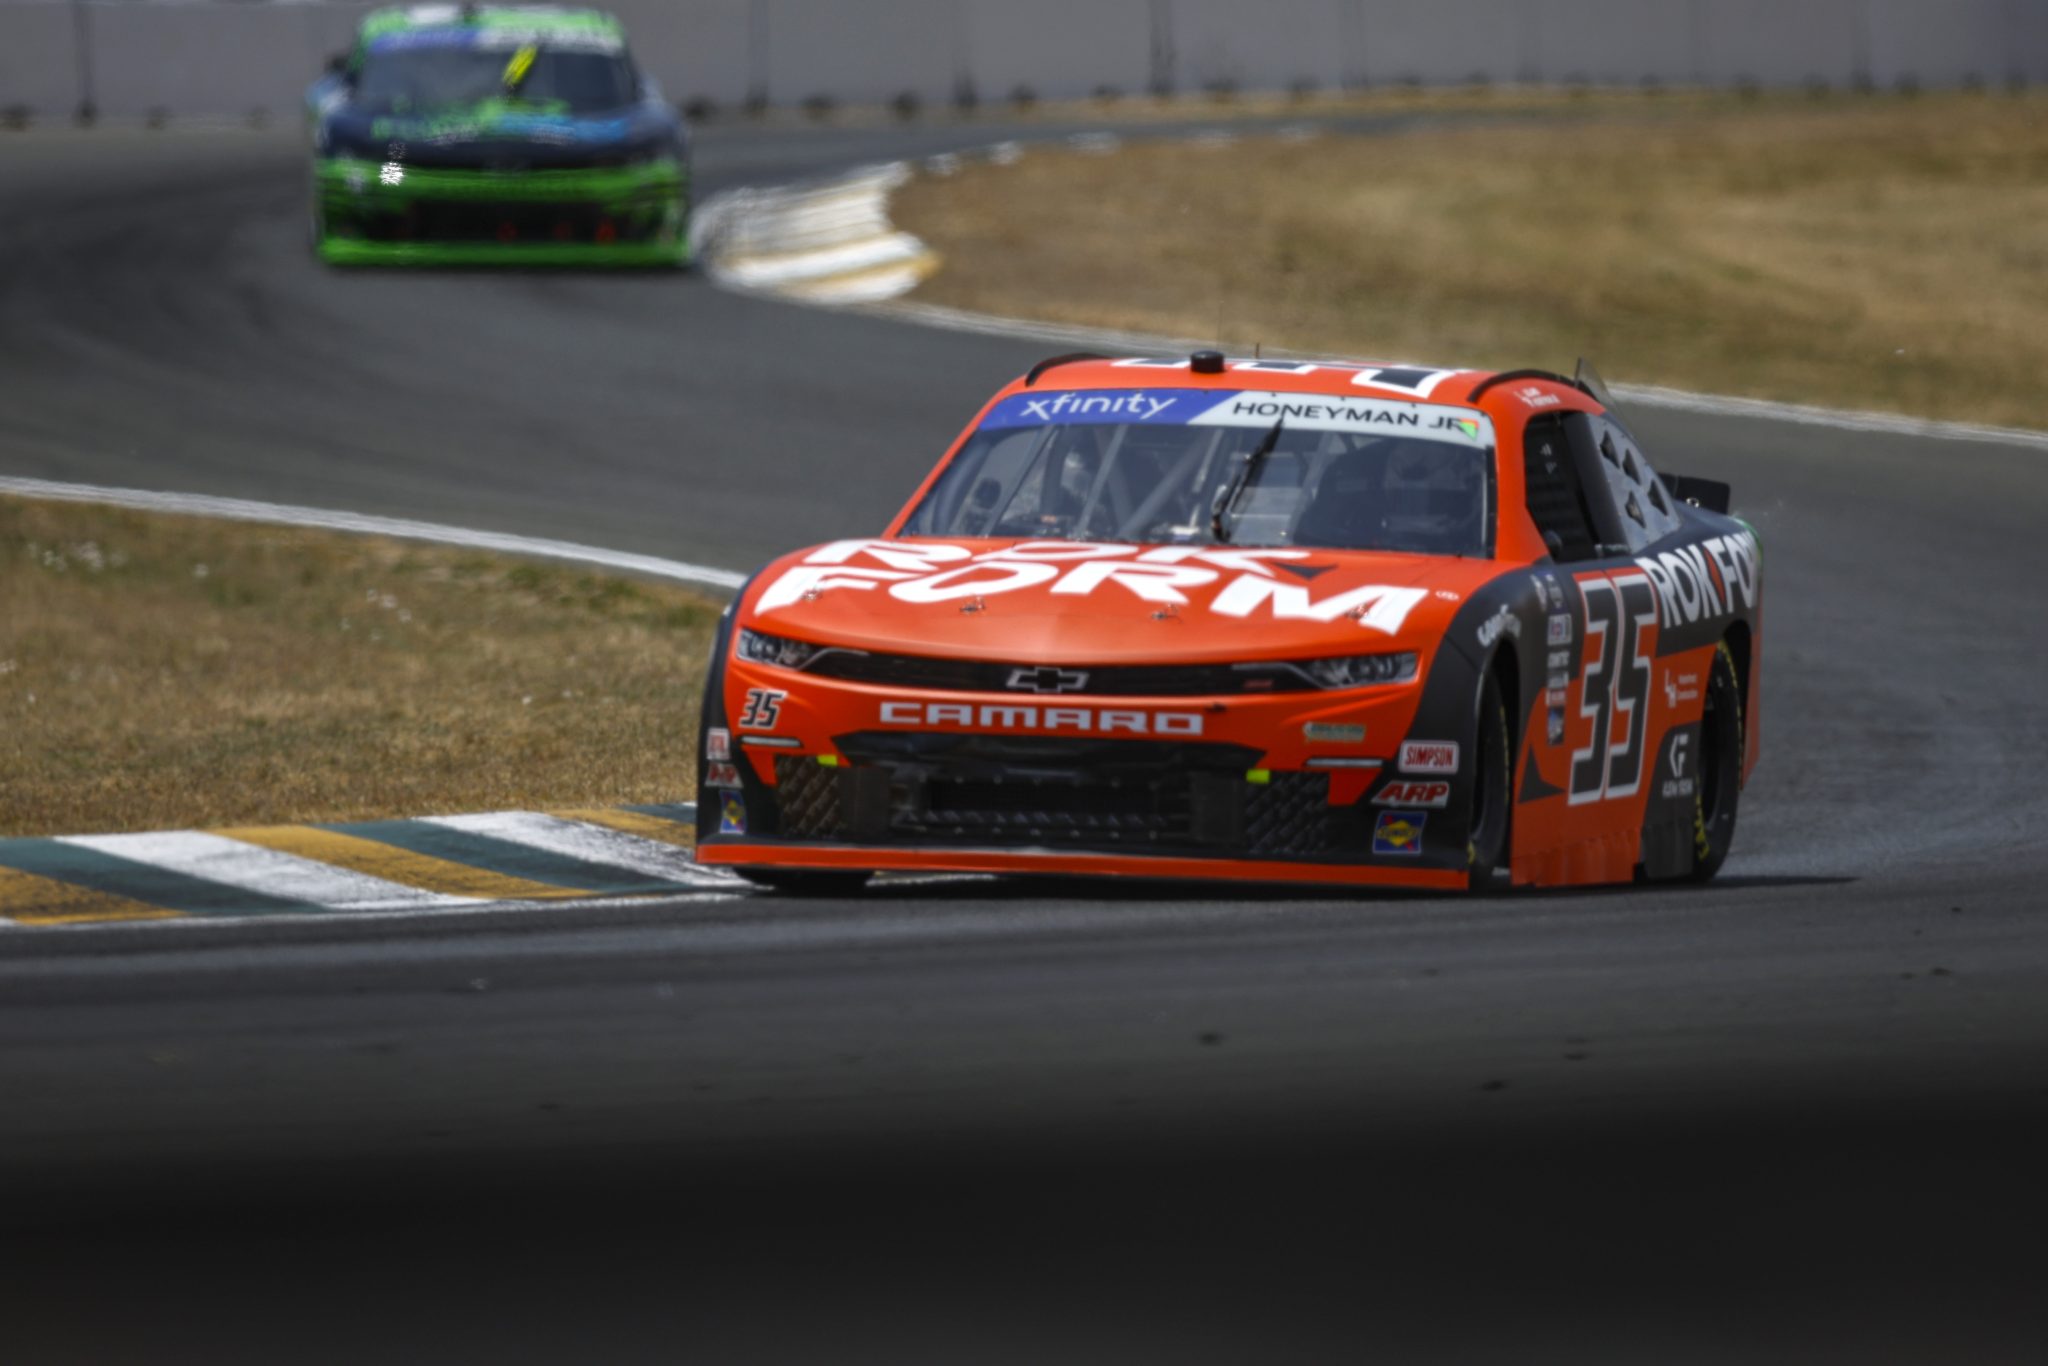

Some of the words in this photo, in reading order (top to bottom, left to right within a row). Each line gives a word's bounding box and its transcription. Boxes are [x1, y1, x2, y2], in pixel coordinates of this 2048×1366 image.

[1020, 392, 1178, 420] xfinity
[1231, 400, 1420, 428] HONEYMAN
[802, 539, 1310, 577] ROK
[754, 560, 1430, 635] FORM
[1567, 571, 1659, 807] 35
[738, 687, 789, 729] 35
[880, 702, 1204, 735] CAMARO
[1405, 746, 1454, 767] SIMPSON
[1378, 783, 1448, 801] ARP
